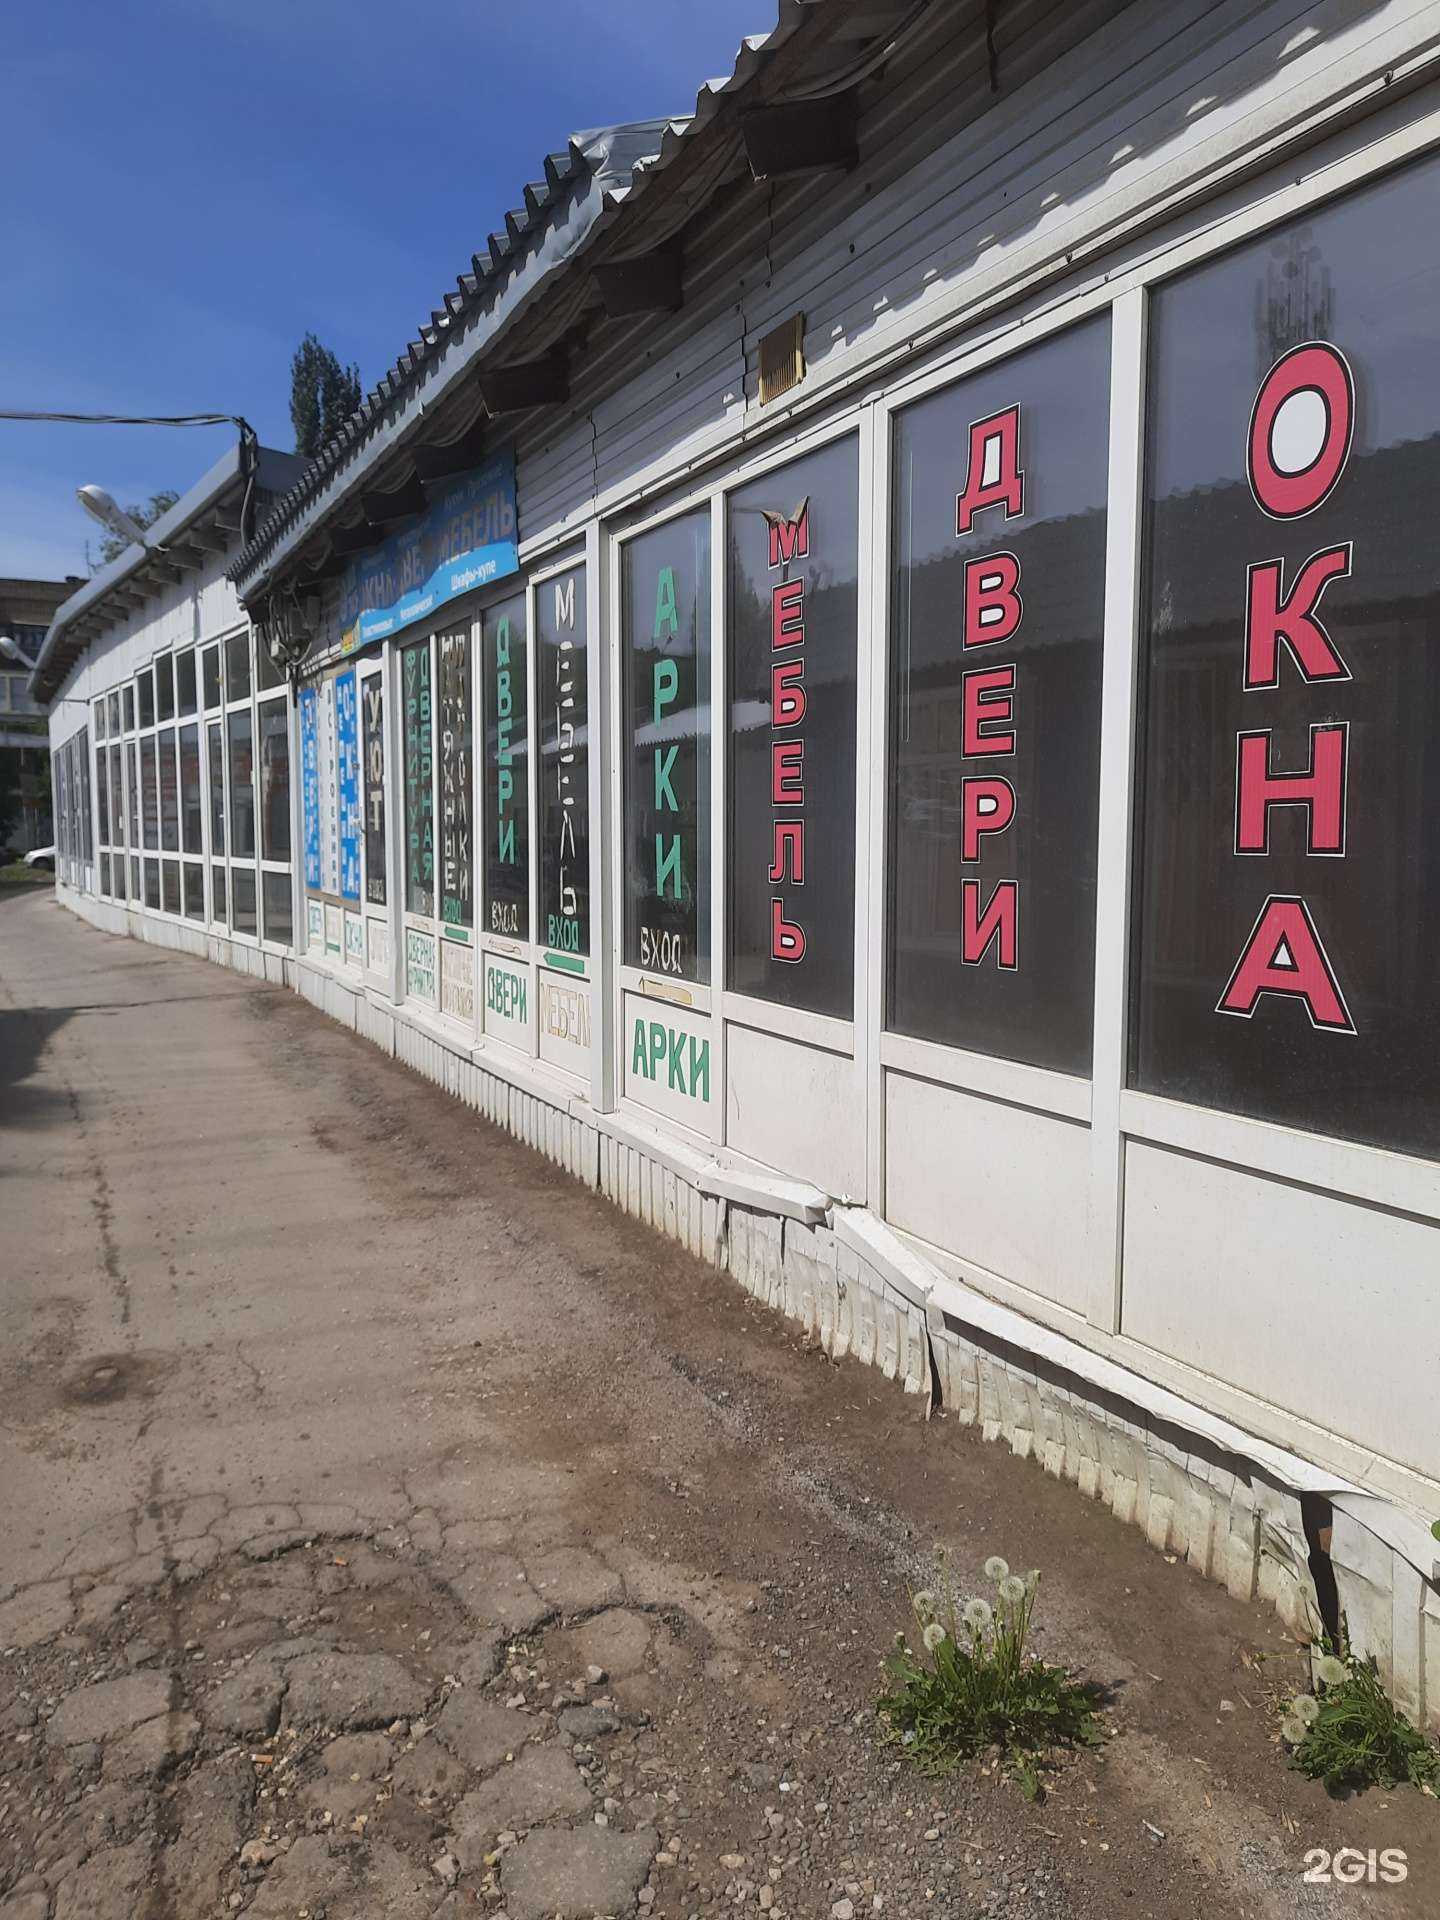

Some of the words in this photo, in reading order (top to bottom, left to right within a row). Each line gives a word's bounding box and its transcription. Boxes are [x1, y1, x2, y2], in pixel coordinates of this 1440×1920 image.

[368, 689, 383, 832] УЮТ
[406, 648, 420, 883] ФУРНИТУРА
[420, 646, 433, 882] ДВЕРНАЯ
[496, 616, 518, 866] ДВЕРИ
[554, 577, 578, 916] МЕБЕЛЬ
[652, 566, 683, 900] АРКИ
[768, 498, 809, 964] МЕБЕЛЬ
[955, 402, 1026, 972] ДВЕРИ
[1215, 339, 1359, 1037] ОКНА
[487, 966, 528, 1025] ДВЕРИ
[491, 901, 519, 933] ВХОД
[548, 914, 580, 952] ВХОД
[640, 927, 684, 974] ВХОД
[632, 1018, 710, 1102] АРКИ
